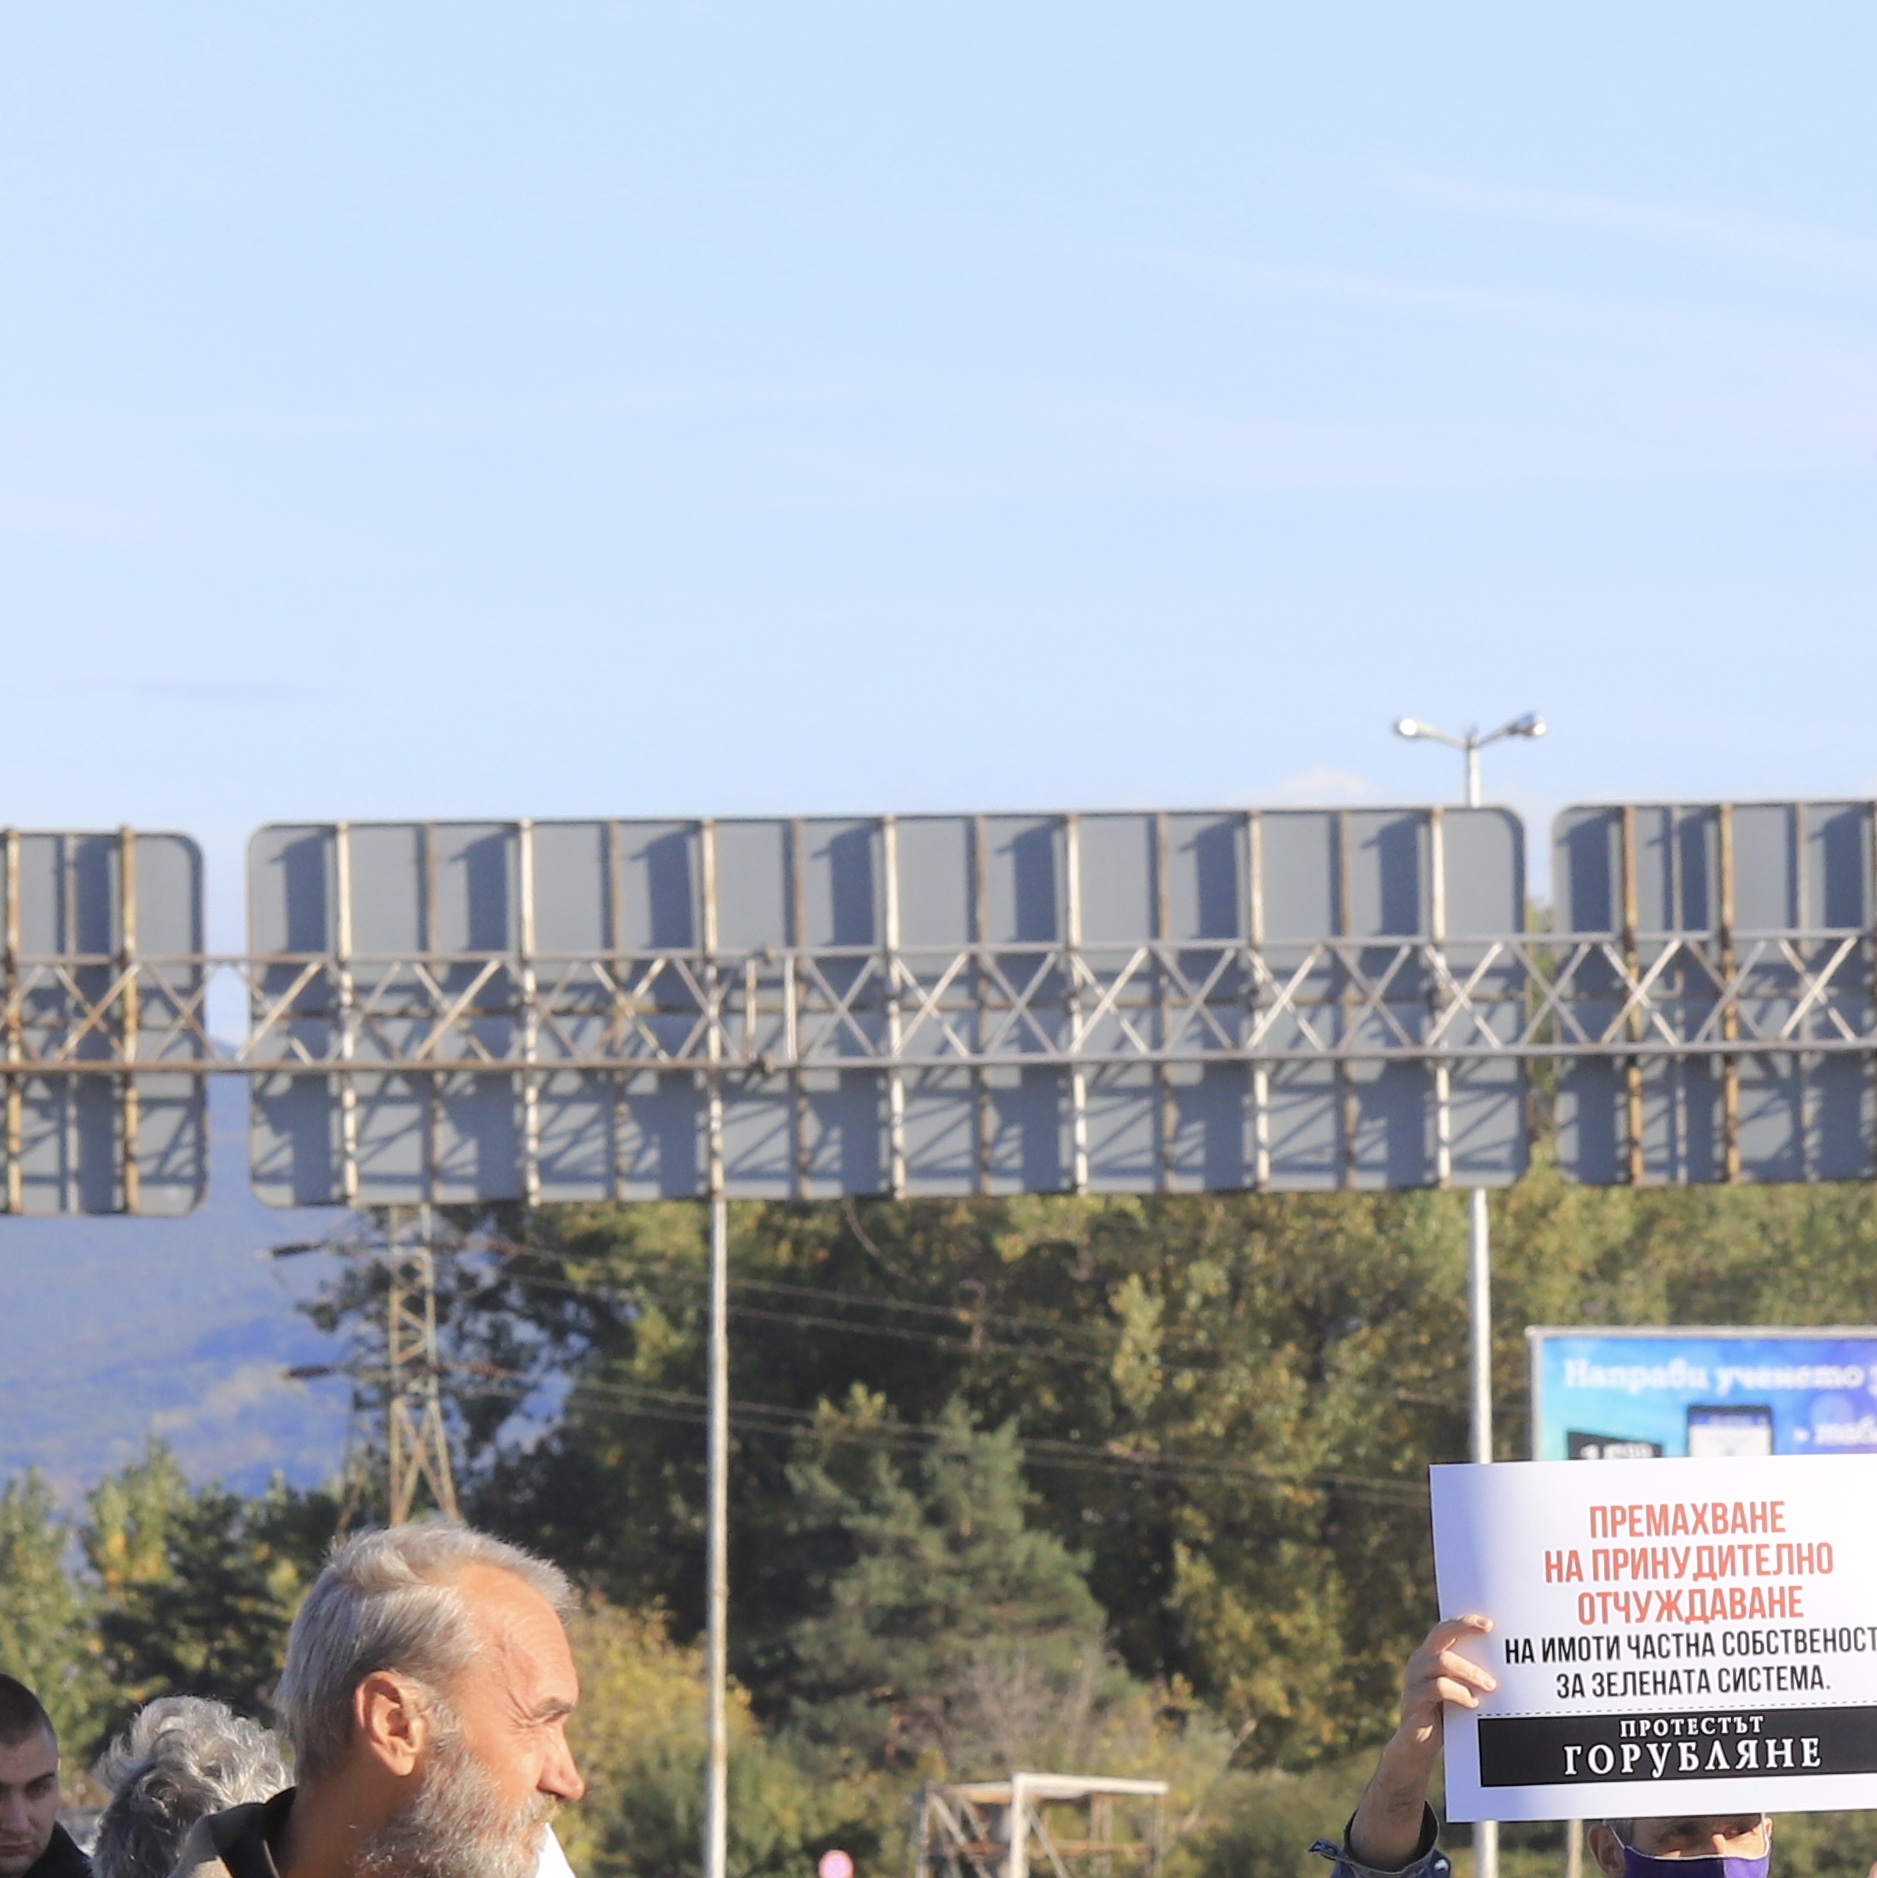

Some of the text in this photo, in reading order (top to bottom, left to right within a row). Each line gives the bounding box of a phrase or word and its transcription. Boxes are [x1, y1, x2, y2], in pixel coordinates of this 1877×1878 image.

[1563, 1357, 1709, 1393] Направи
[1714, 1364, 1865, 1395] ученето
[1589, 1500, 1787, 1539] ПРЕМАХВАНЕ
[1544, 1541, 1834, 1584] НА ПРИНУДИТЕЛНО
[1577, 1585, 1804, 1626] ОТЧУЖДАВАНЕ
[1504, 1637, 1536, 1665] НА
[1541, 1634, 1621, 1663] ИМОТИ
[1626, 1630, 1715, 1660] ЧАСТНА
[1556, 1665, 1831, 1700] ЗА ЗЕЛЕНАТА СИСТЕМА.
[1619, 1715, 1765, 1739] ПРОТЕСТЪТ
[1563, 1737, 1823, 1776] ГОРУБЛЯНЕ
